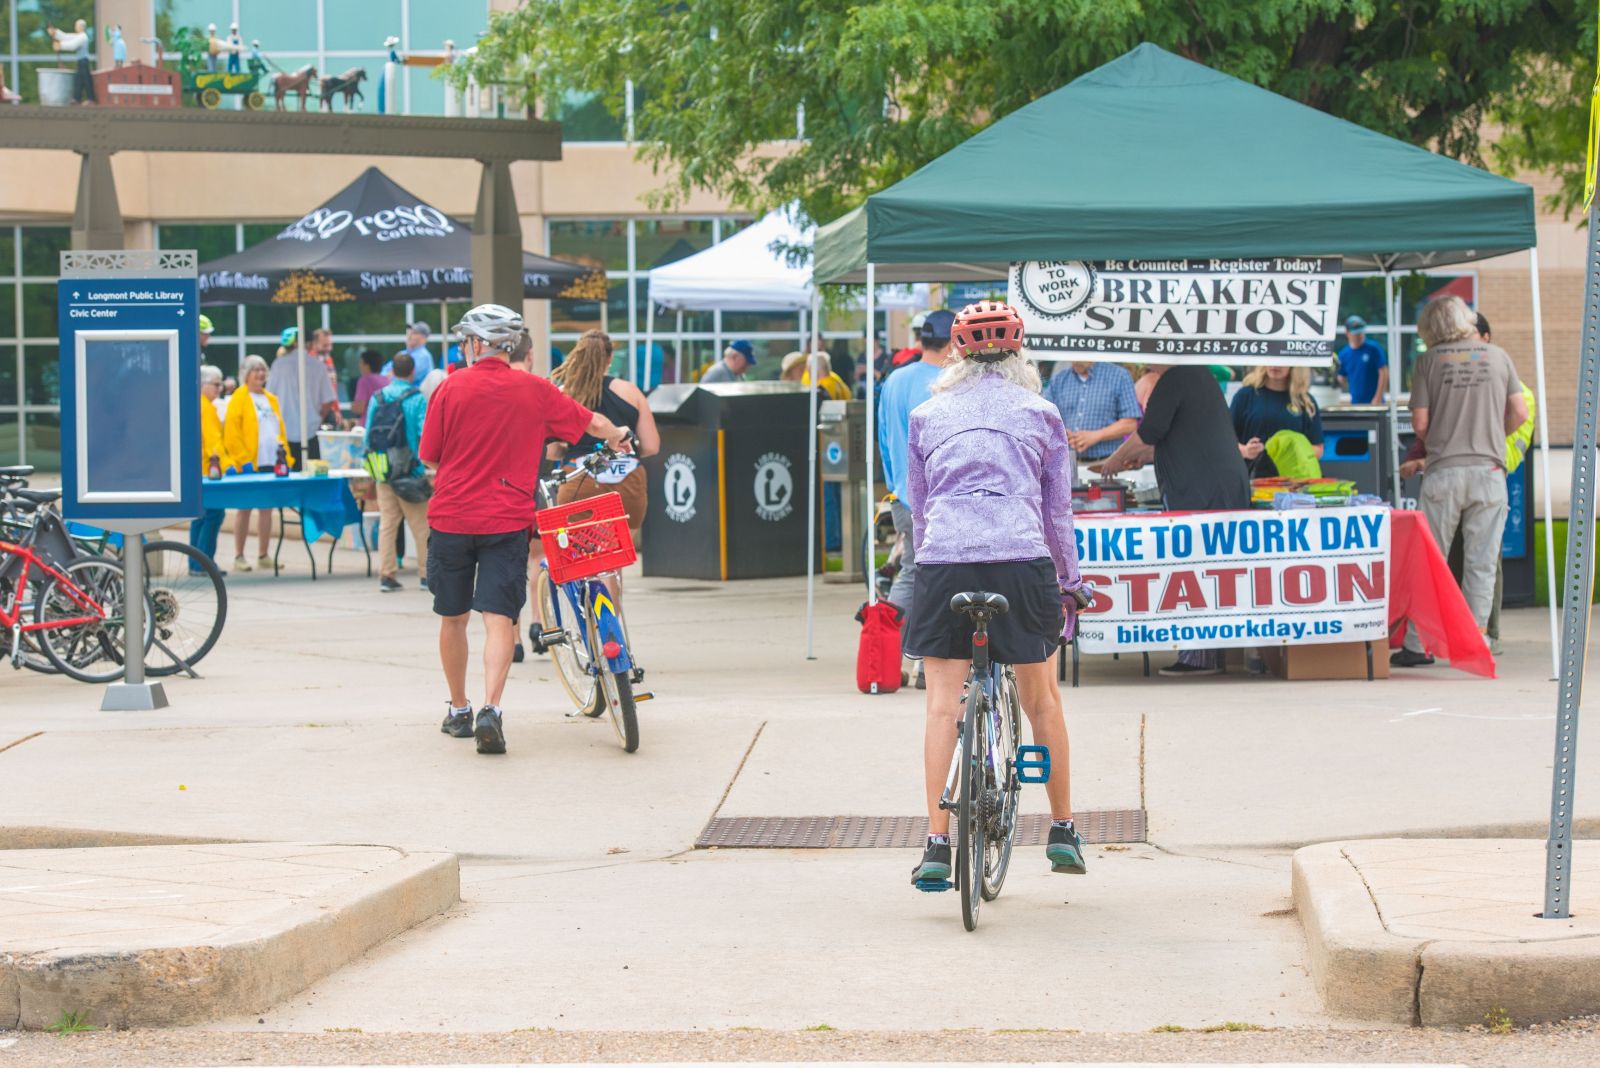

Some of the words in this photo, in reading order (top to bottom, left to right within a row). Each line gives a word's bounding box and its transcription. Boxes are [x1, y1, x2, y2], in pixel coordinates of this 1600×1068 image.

[1047, 268, 1066, 280] TO
[1105, 259, 1125, 271] Be
[1128, 259, 1188, 272] Counted
[1209, 258, 1271, 274] Register
[1273, 258, 1322, 274] Today!
[1038, 277, 1080, 294] WORK
[1103, 278, 1335, 305] BREAKFAST
[88, 291, 128, 301] Longmont
[129, 291, 153, 300] Public
[155, 291, 184, 301] Library
[1048, 290, 1074, 304] DAY
[69, 309, 89, 318] Civic
[90, 309, 118, 318] Center
[1084, 305, 1327, 336] STATION
[1023, 335, 1141, 352] www.drcog.org
[1156, 340, 1269, 354] 303-458-7665
[1074, 527, 1143, 561] BIKE
[1150, 524, 1192, 559] TO
[1201, 517, 1311, 556] WORK
[1320, 514, 1384, 551] DAY
[1082, 560, 1385, 615] STATION
[1117, 618, 1343, 644] biketoworkday.us
